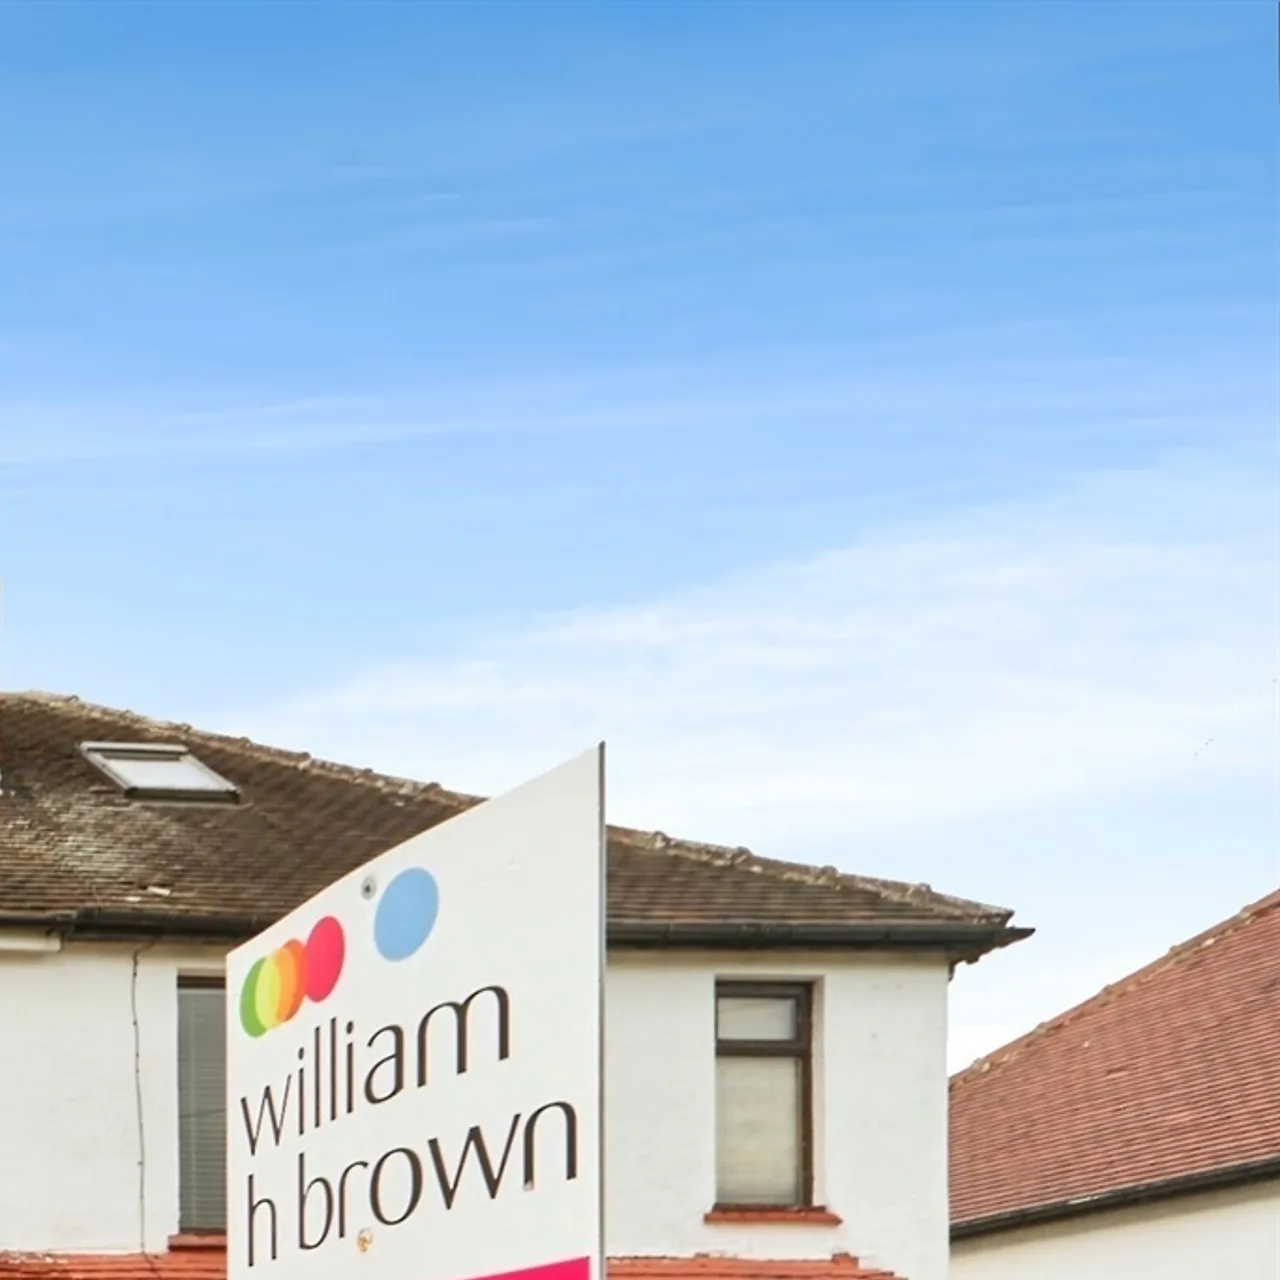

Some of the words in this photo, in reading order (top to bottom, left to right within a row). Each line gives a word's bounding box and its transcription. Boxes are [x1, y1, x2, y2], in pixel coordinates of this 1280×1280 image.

[240, 984, 510, 1156] william
[246, 1173, 277, 1267] h
[298, 1100, 579, 1251] brown
